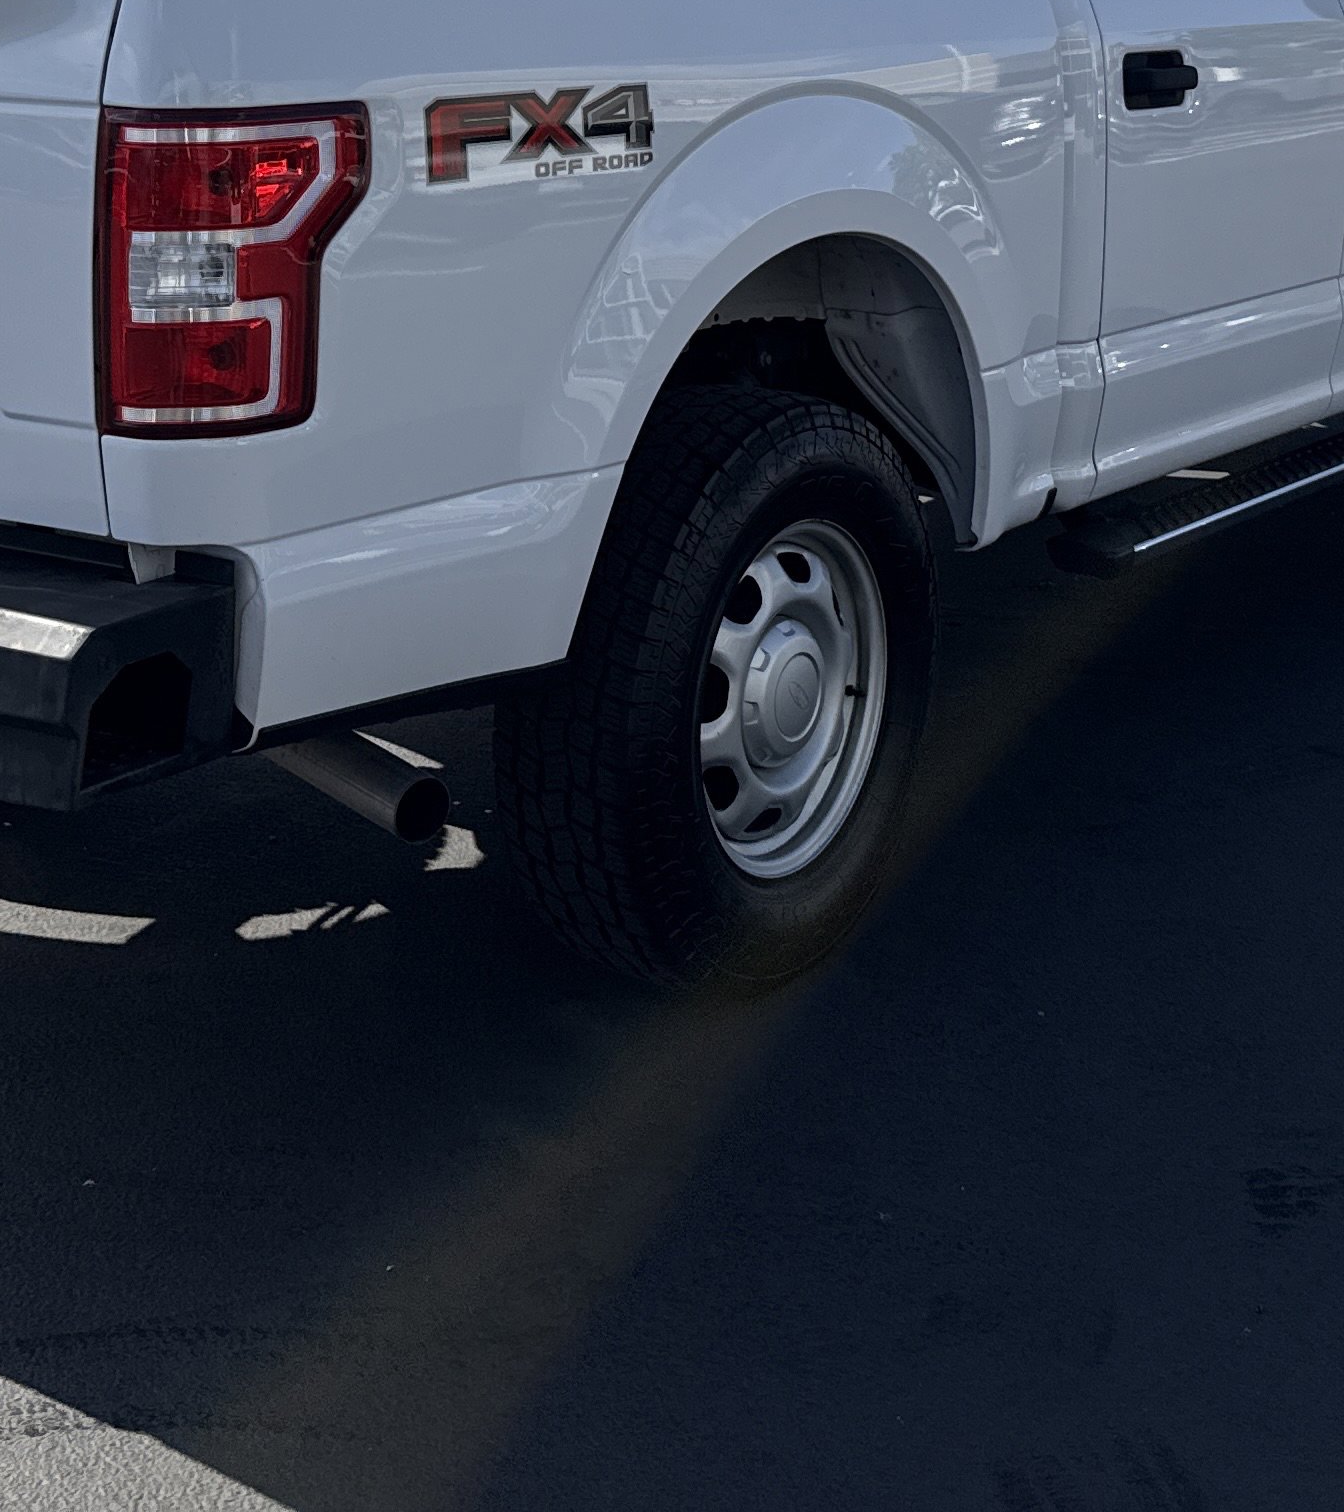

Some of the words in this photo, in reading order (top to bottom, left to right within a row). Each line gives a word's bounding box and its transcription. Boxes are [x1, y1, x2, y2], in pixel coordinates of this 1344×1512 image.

[423, 81, 655, 187] FX4
[534, 157, 584, 178] OFF
[591, 151, 654, 172] ROAD
